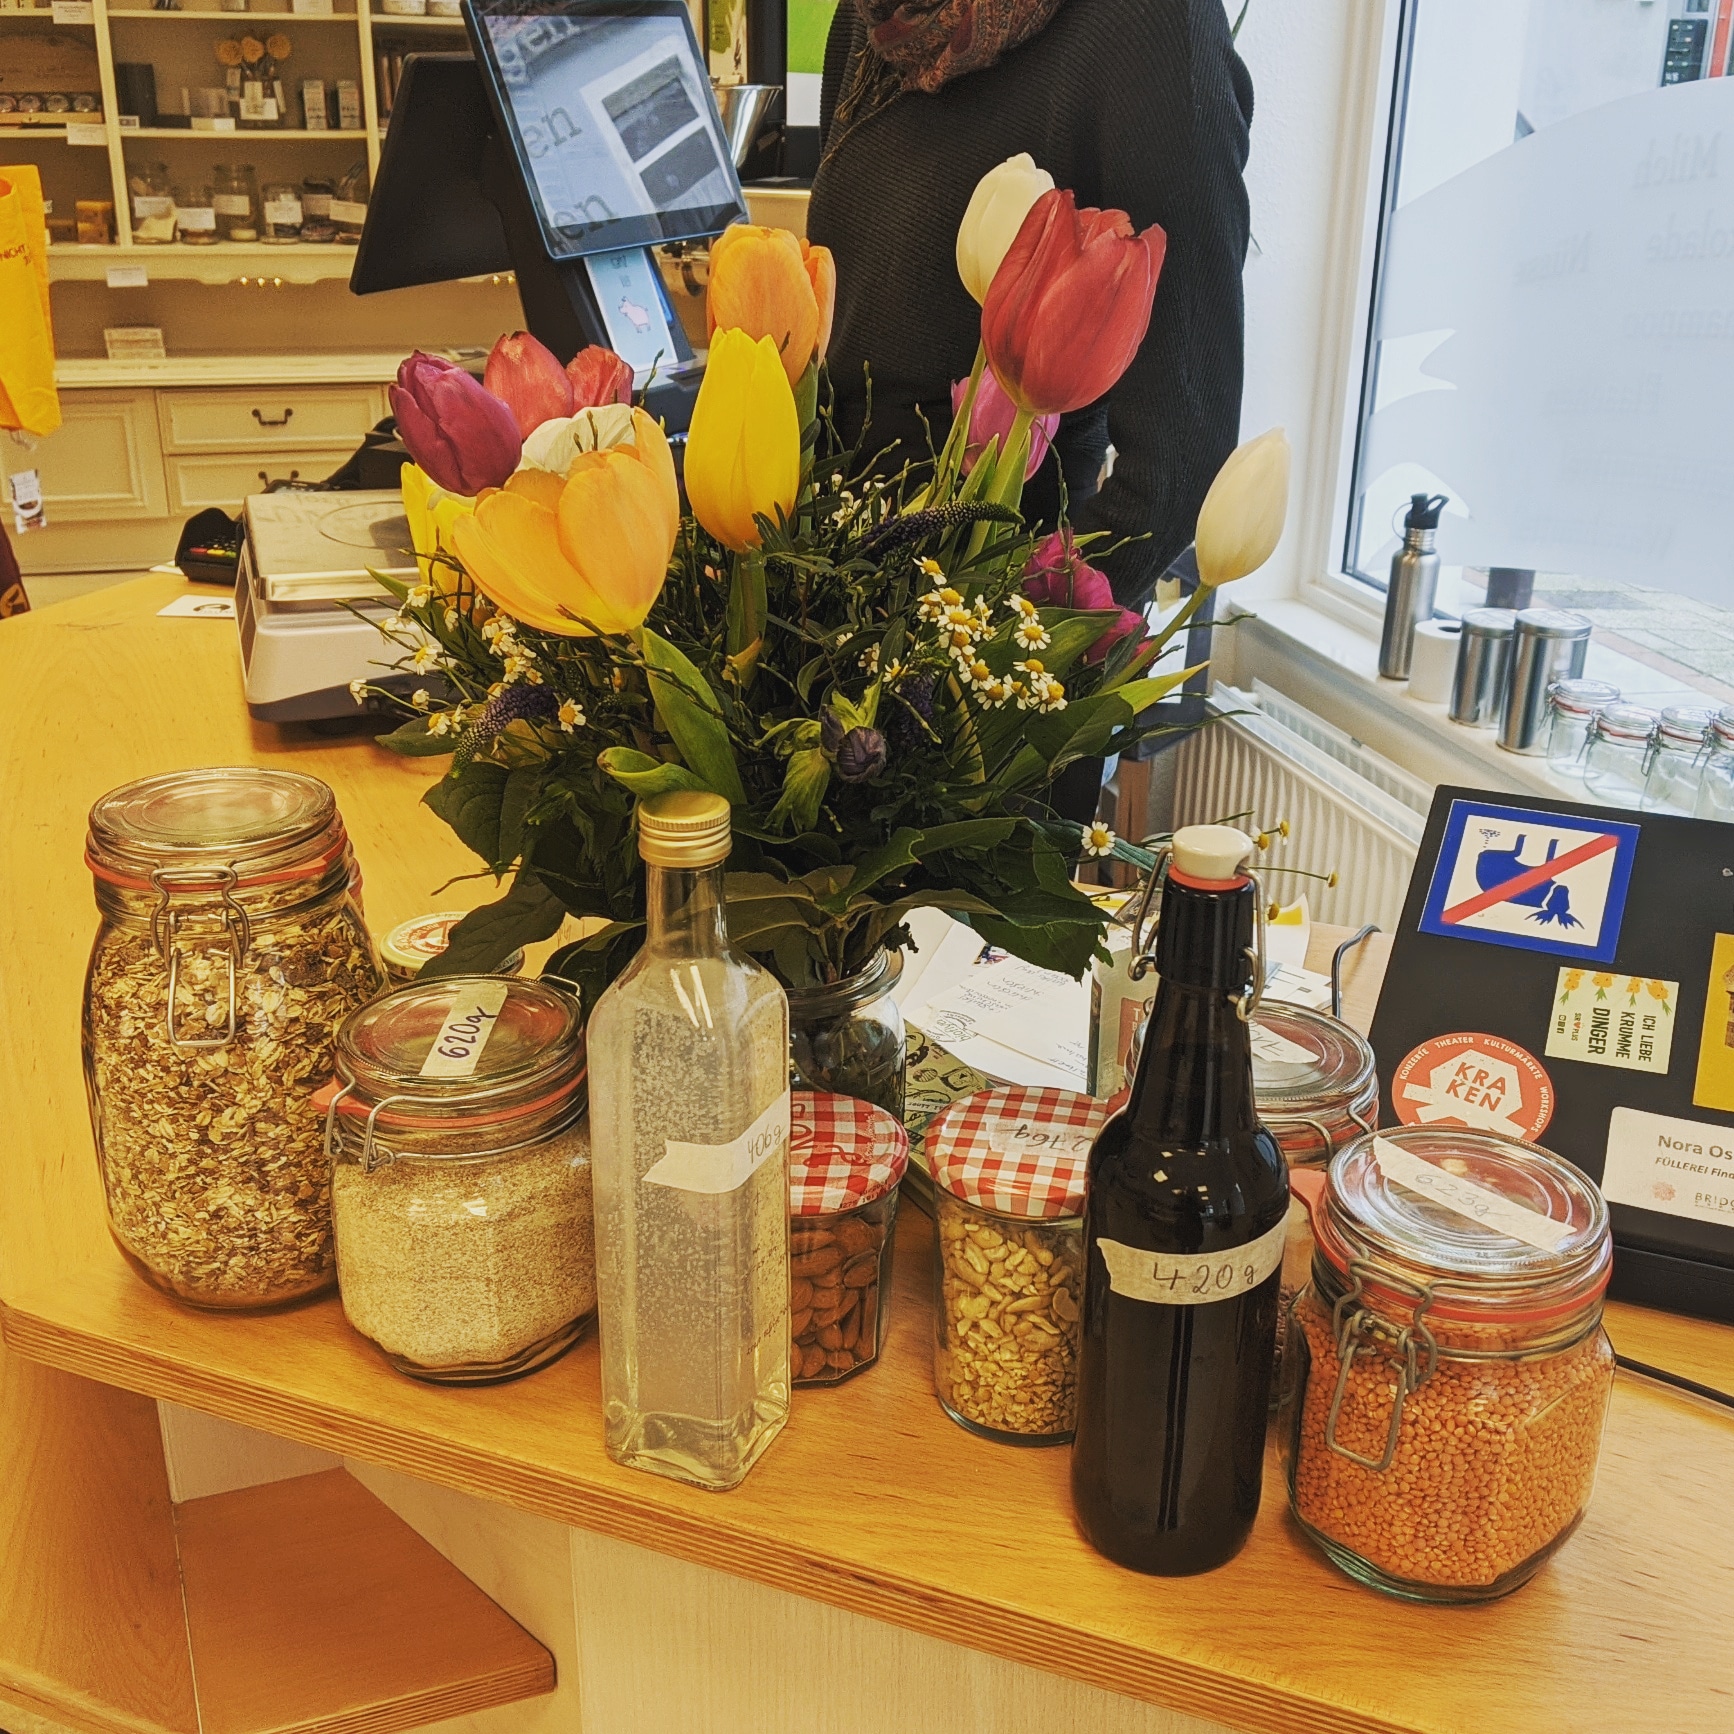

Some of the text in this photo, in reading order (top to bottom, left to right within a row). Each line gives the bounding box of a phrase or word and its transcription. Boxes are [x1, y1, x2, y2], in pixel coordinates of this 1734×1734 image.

[1434, 1036, 1474, 1048] THEATER
[1587, 1007, 1610, 1055] DINGER
[1615, 1011, 1635, 1059] KRUMME
[1638, 1015, 1656, 1062] ICH LIEBE
[1399, 1048, 1429, 1080] KONZERTE
[1483, 1038, 1543, 1080] KULTURMÄRKTE
[1445, 1079, 1502, 1112] KEN
[1455, 1061, 1506, 1096] KRA
[1531, 1086, 1549, 1132] WORKSHOPS
[1657, 1135, 1703, 1155] Nora
[1654, 1156, 1709, 1174] FÜLLEREI
